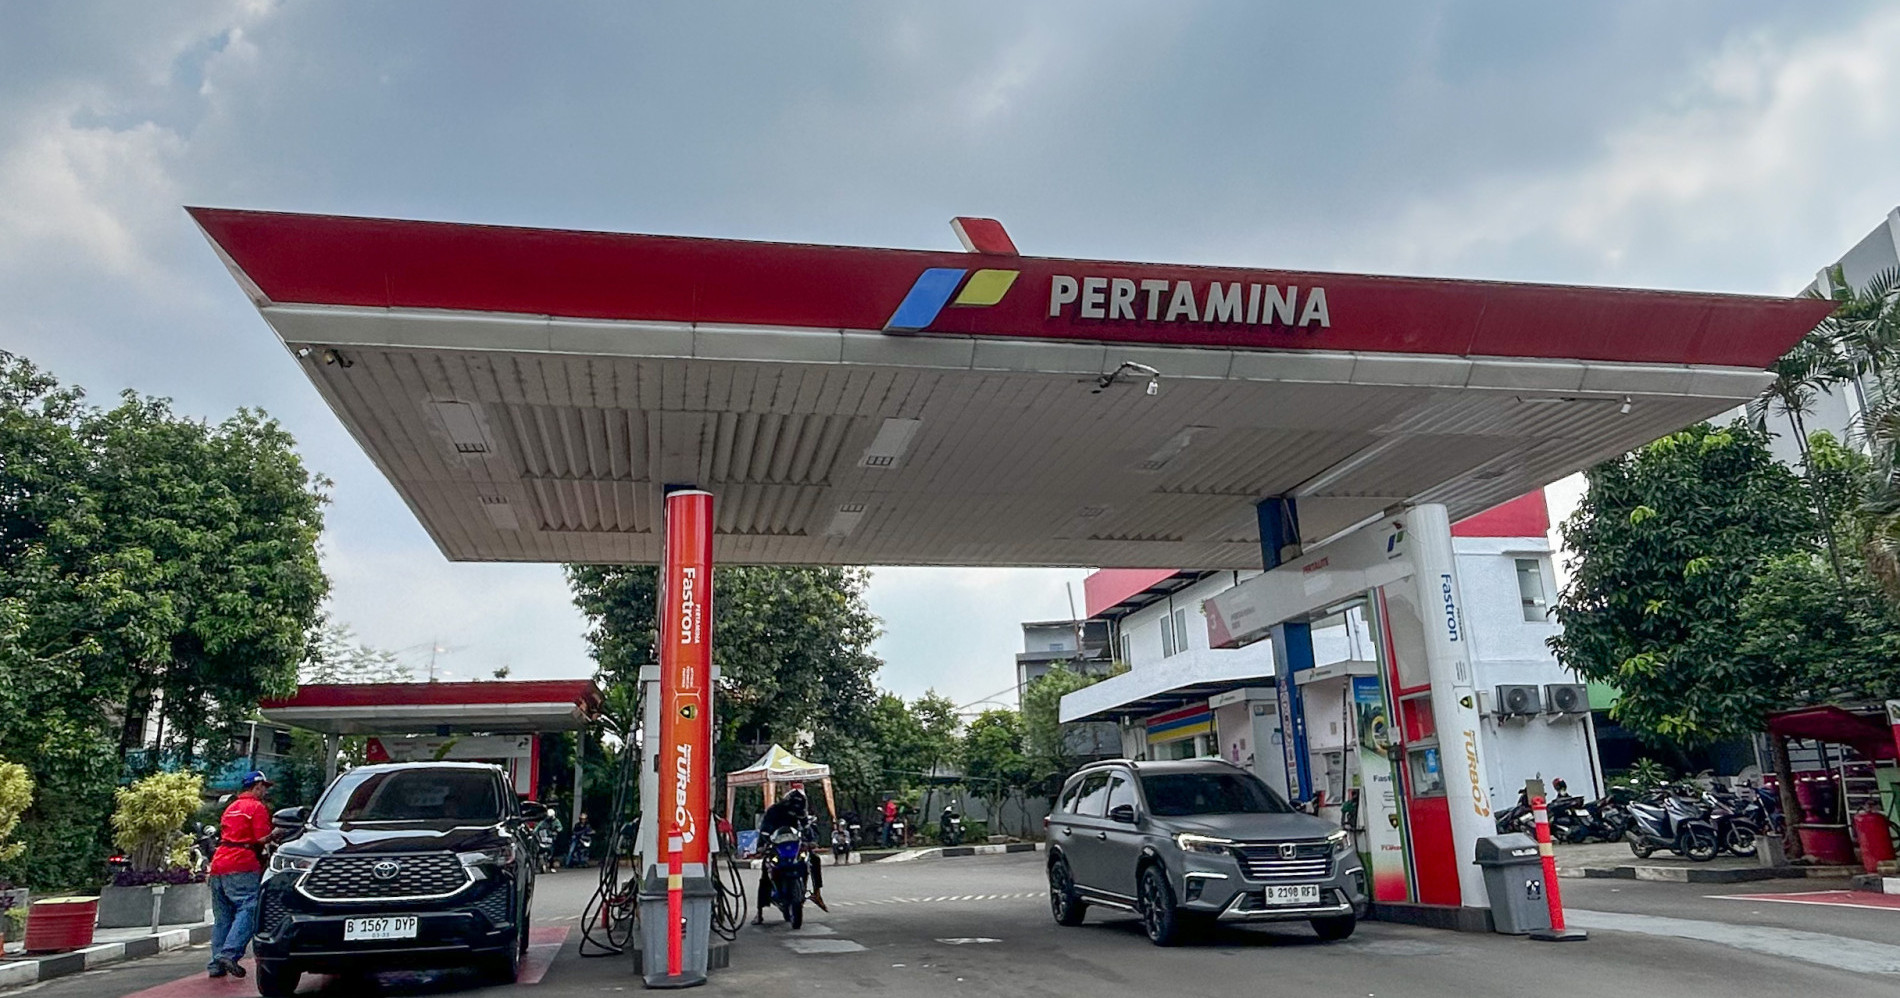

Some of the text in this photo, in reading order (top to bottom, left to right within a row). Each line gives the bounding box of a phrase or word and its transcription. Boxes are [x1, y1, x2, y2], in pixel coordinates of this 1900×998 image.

[1050, 275, 1330, 328] PERTAMINA
[681, 567, 696, 645] Fastron
[1210, 615, 1218, 630] 3
[1441, 574, 1458, 642] Fastron
[675, 744, 690, 828] TURBO
[1373, 774, 1391, 783] Fast
[1463, 728, 1482, 803] TURBO
[1268, 887, 1274, 898] B
[347, 918, 416, 933] B 1567 DYP
